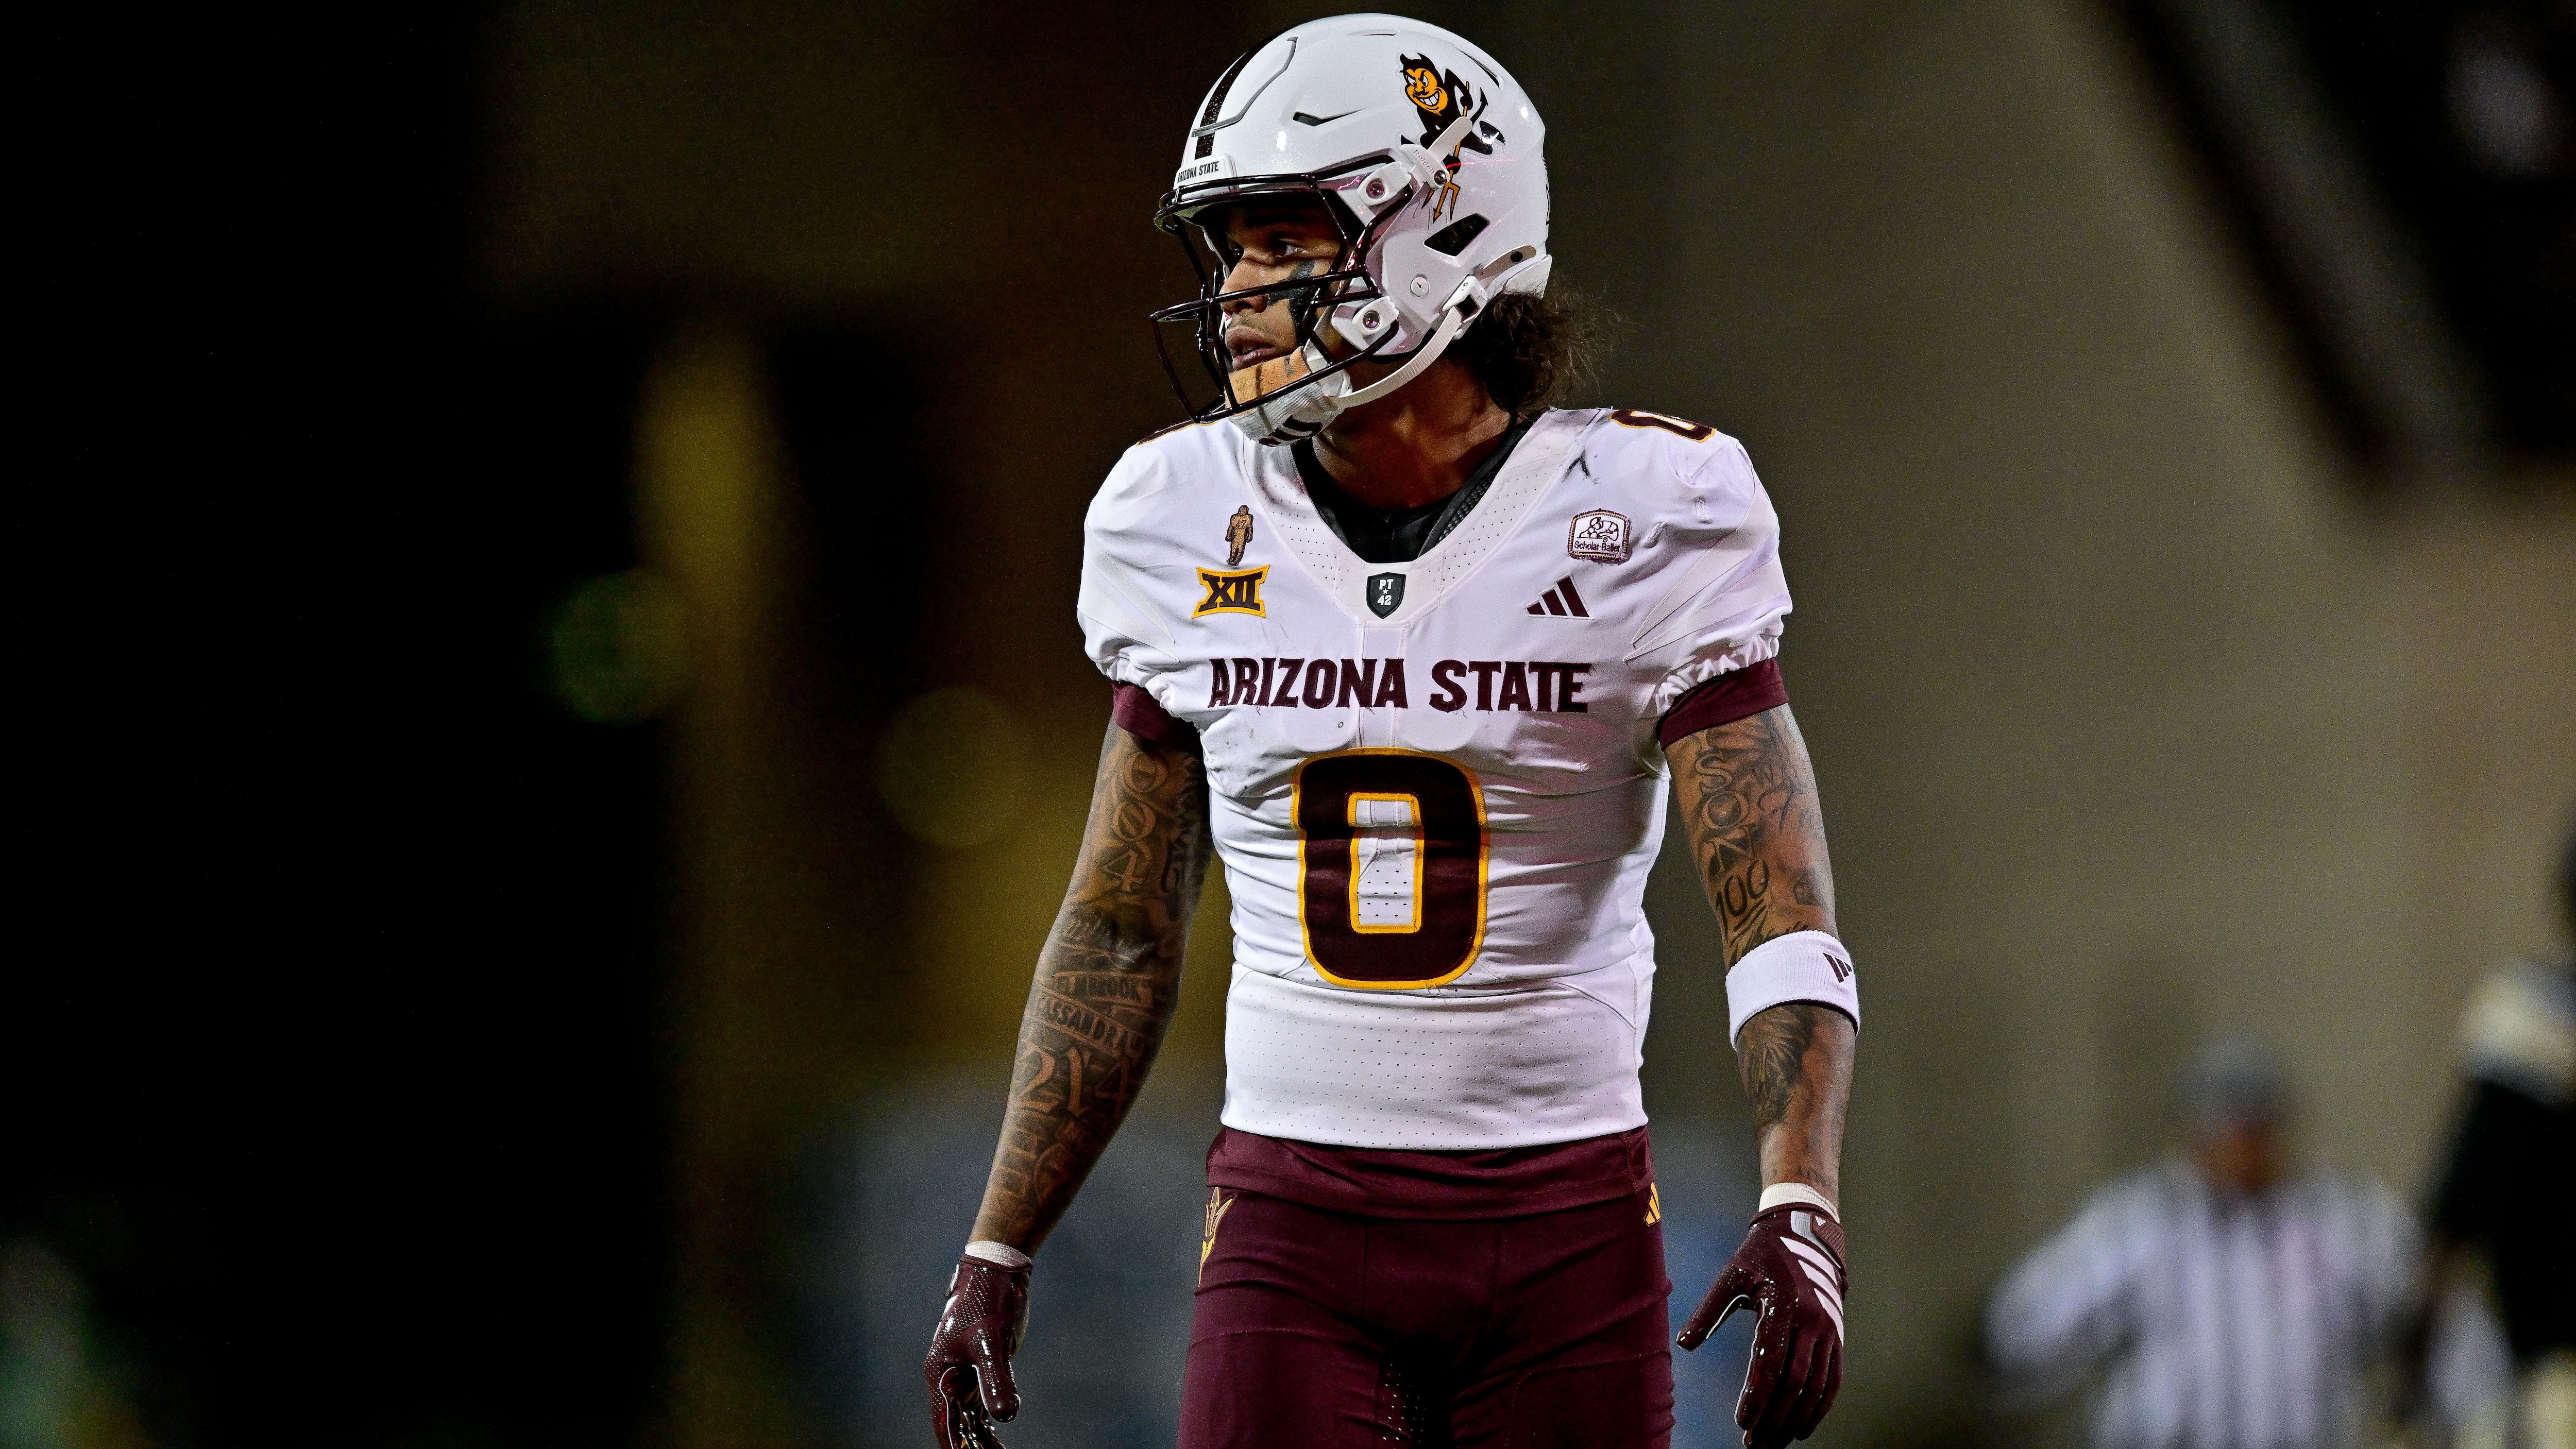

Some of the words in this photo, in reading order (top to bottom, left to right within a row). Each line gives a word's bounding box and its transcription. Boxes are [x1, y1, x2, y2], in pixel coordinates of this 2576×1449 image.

[1177, 166, 1197, 183] ARIZONA
[1198, 161, 1219, 176] STATE
[1574, 541, 1620, 552] Scholar-Baller
[1198, 571, 1264, 612] XII
[1377, 594, 1392, 606] 42
[1379, 578, 1394, 590] PT
[1207, 657, 1409, 709] ARIZONA
[1429, 659, 1592, 713] STATE
[1291, 746, 1492, 990] 0
[1716, 859, 1770, 942] 100
[1016, 1043, 1131, 1122] 214
